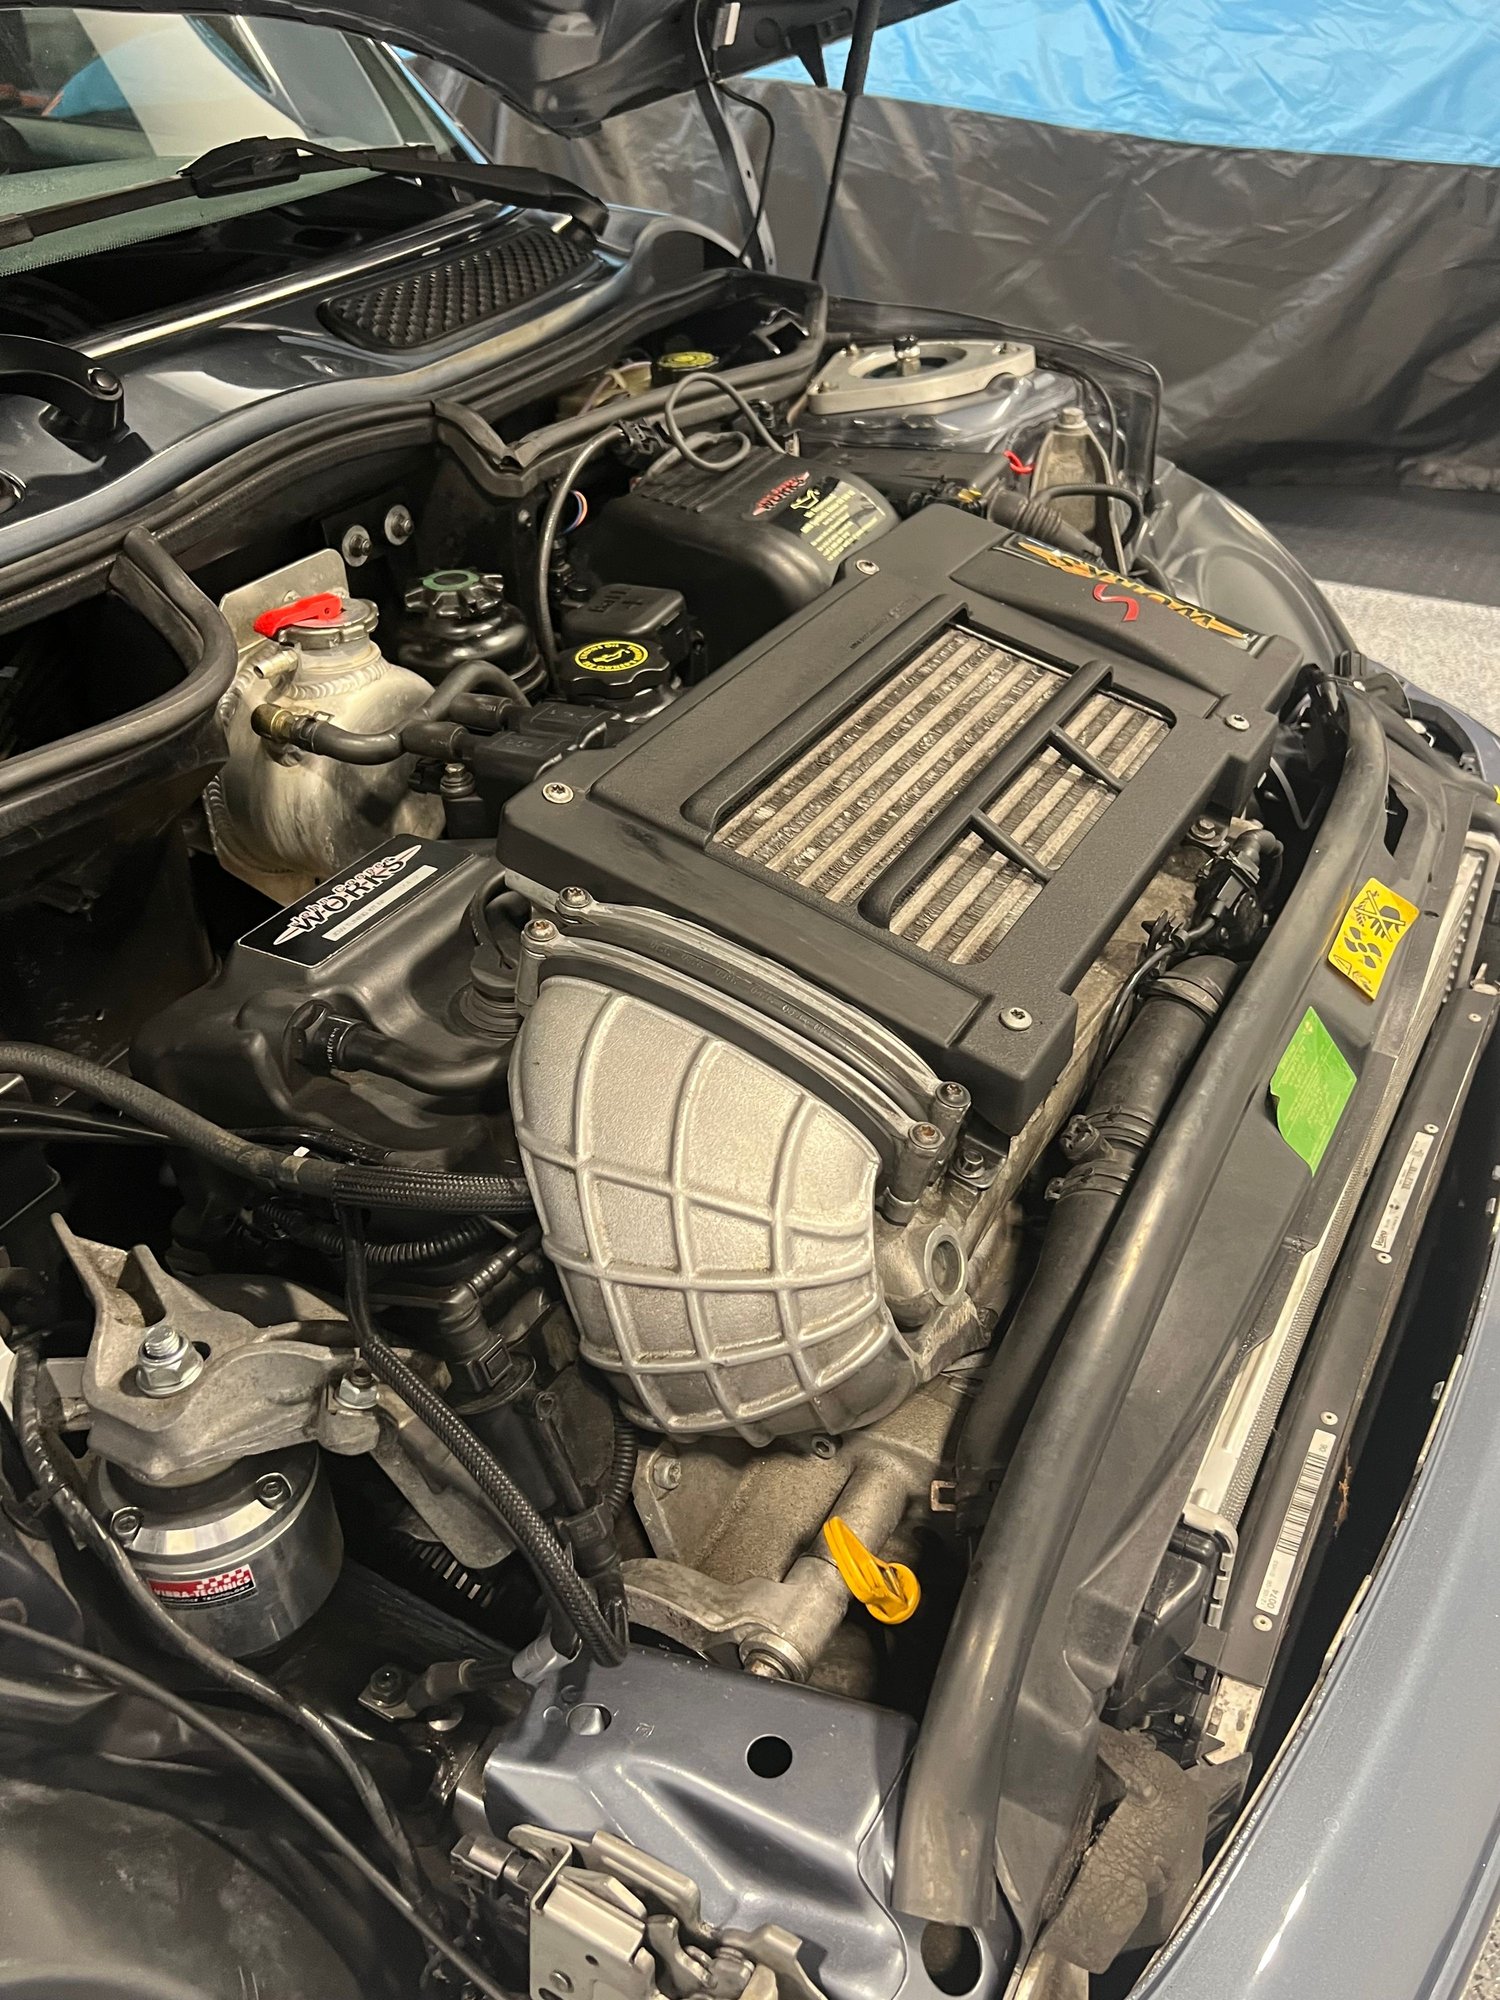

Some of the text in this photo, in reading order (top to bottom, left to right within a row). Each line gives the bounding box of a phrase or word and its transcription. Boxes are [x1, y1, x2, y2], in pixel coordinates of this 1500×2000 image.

[1093, 583, 1140, 622] S
[296, 858, 405, 931] WORKS
[154, 1575, 251, 1599] VIBRA-TECHNICS
[1267, 1589, 1279, 1609] 0074
